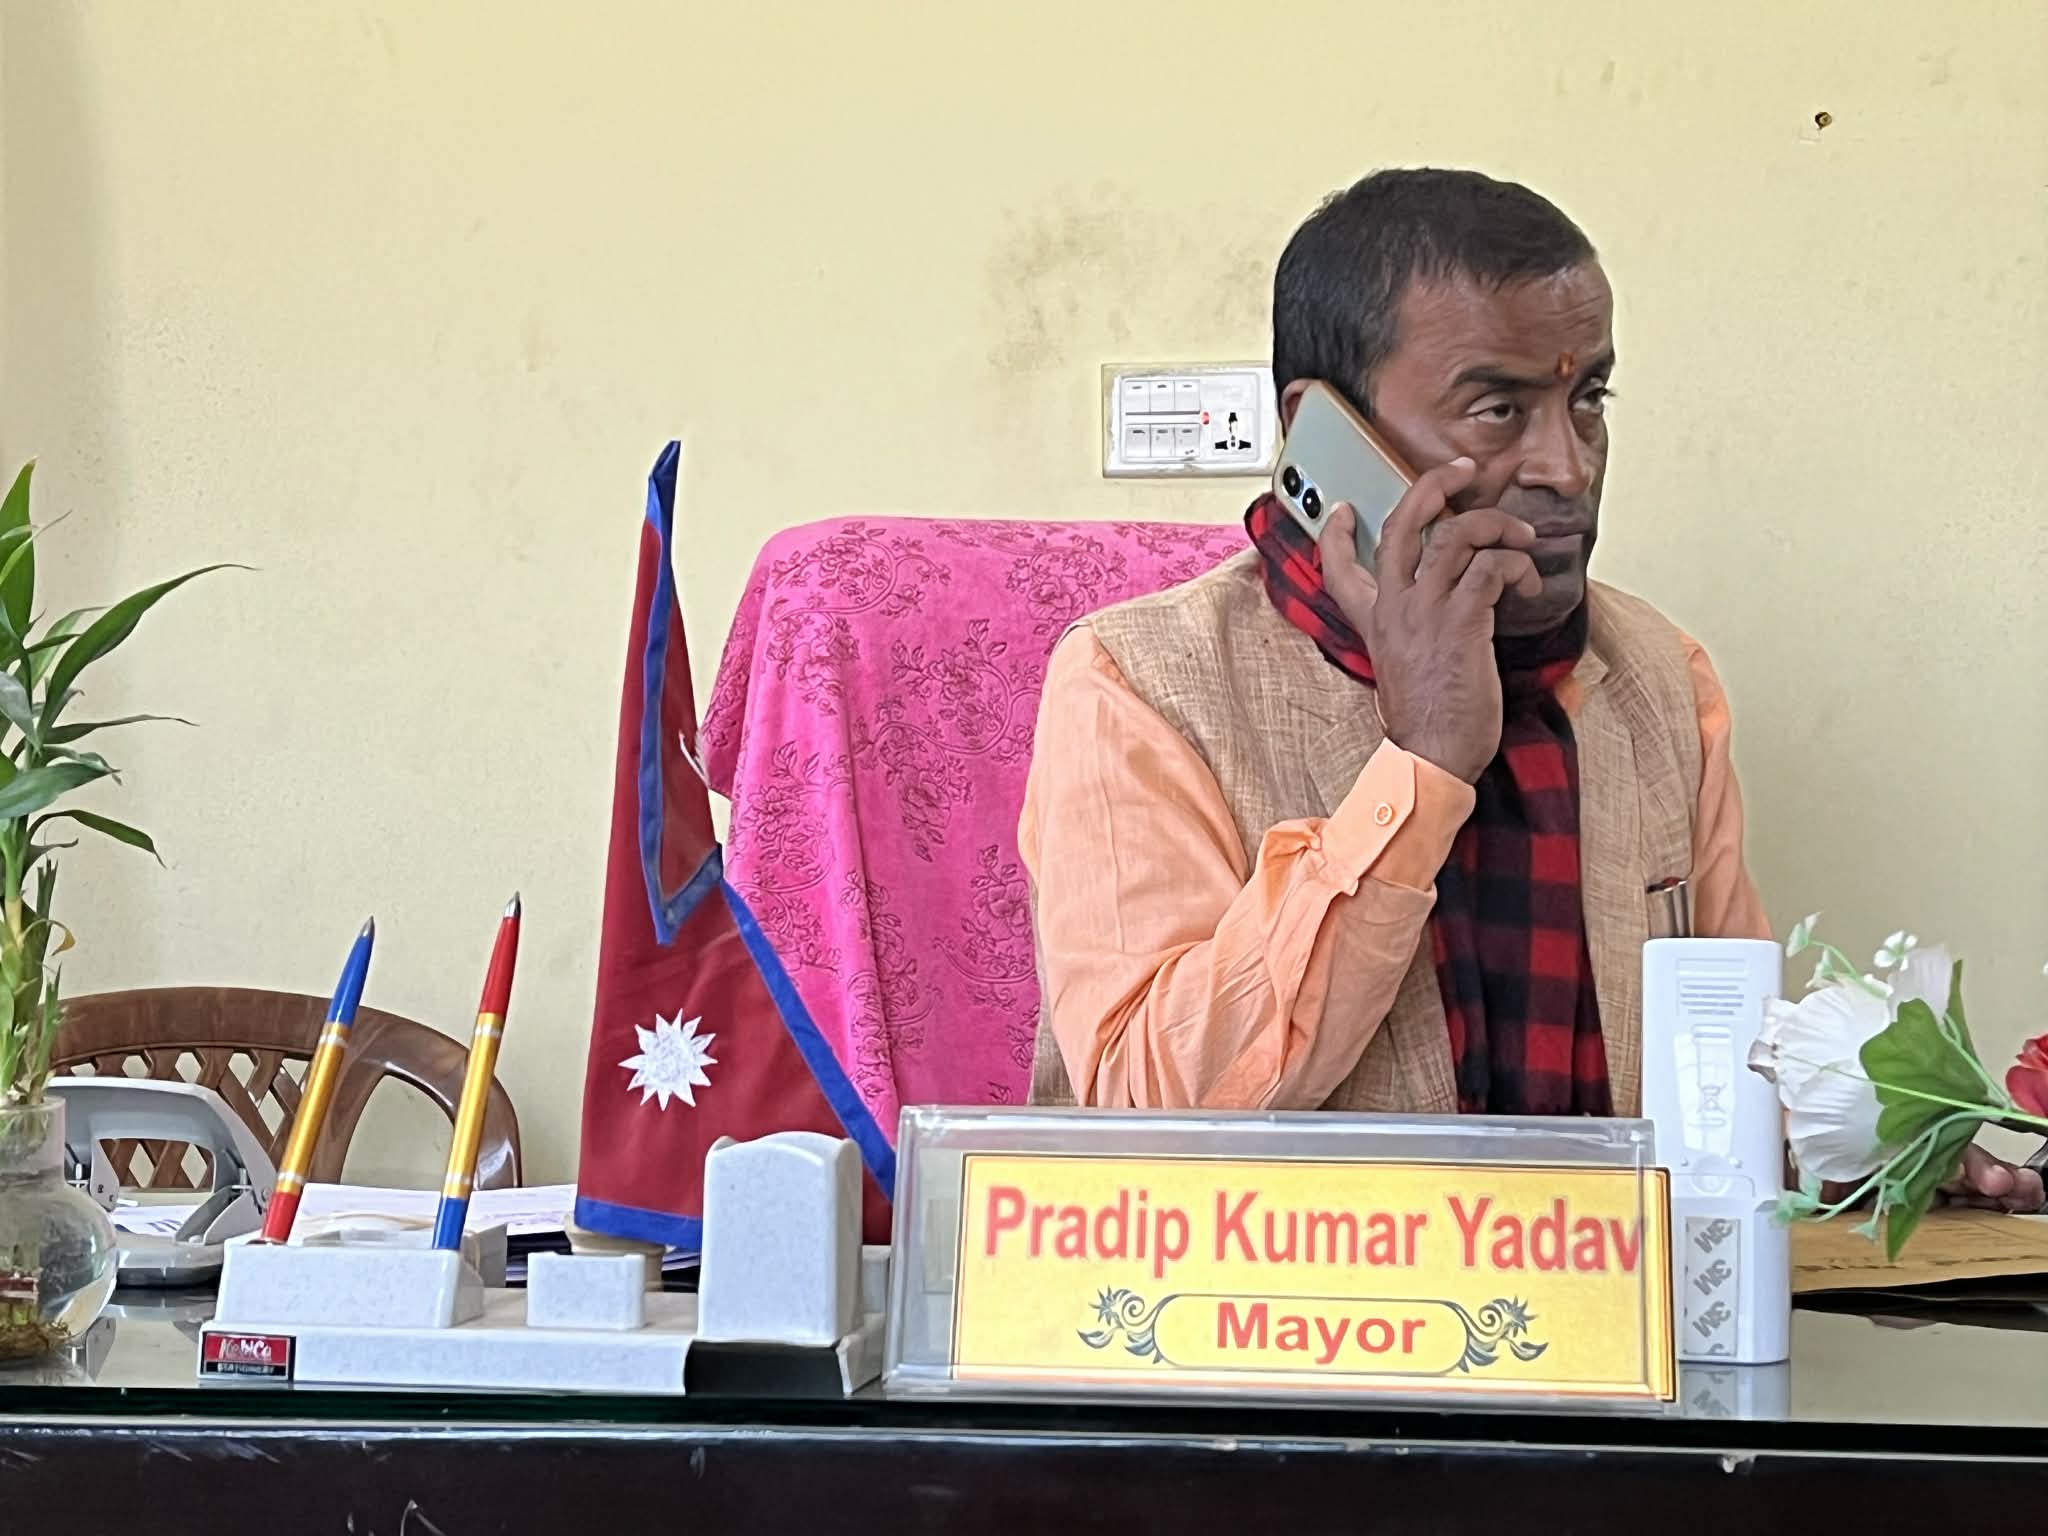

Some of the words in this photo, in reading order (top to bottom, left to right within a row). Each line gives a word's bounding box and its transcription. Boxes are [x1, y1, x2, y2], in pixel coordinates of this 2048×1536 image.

[985, 1185, 1190, 1279] Pradip
[1214, 1190, 1428, 1267] Kumar
[1447, 1195, 1645, 1272] Yadav
[1693, 1258, 1732, 1296] 3M
[1216, 1301, 1427, 1365] Mayor
[1692, 1300, 1732, 1338] 3M
